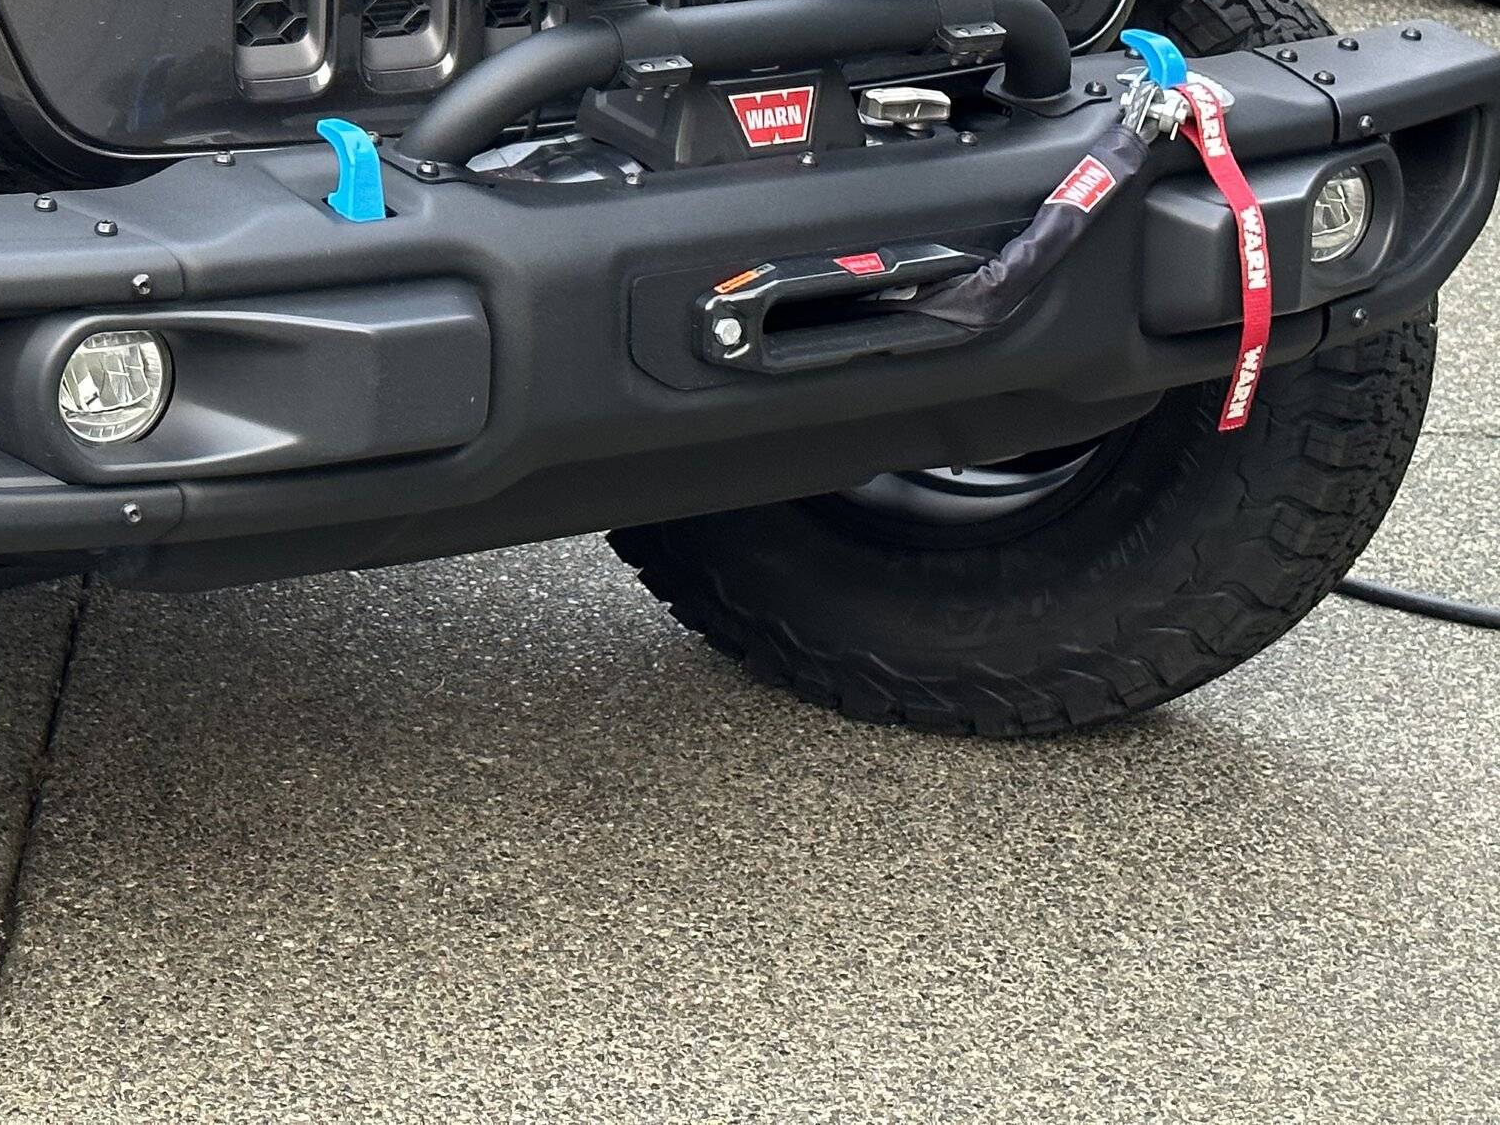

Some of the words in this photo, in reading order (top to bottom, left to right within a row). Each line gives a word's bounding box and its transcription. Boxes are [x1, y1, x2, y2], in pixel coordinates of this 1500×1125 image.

[745, 104, 803, 131] WARN
[1185, 83, 1227, 158] WARN
[1063, 165, 1106, 203] WARN
[1240, 205, 1268, 290] WARN
[1226, 344, 1263, 419] WARN
